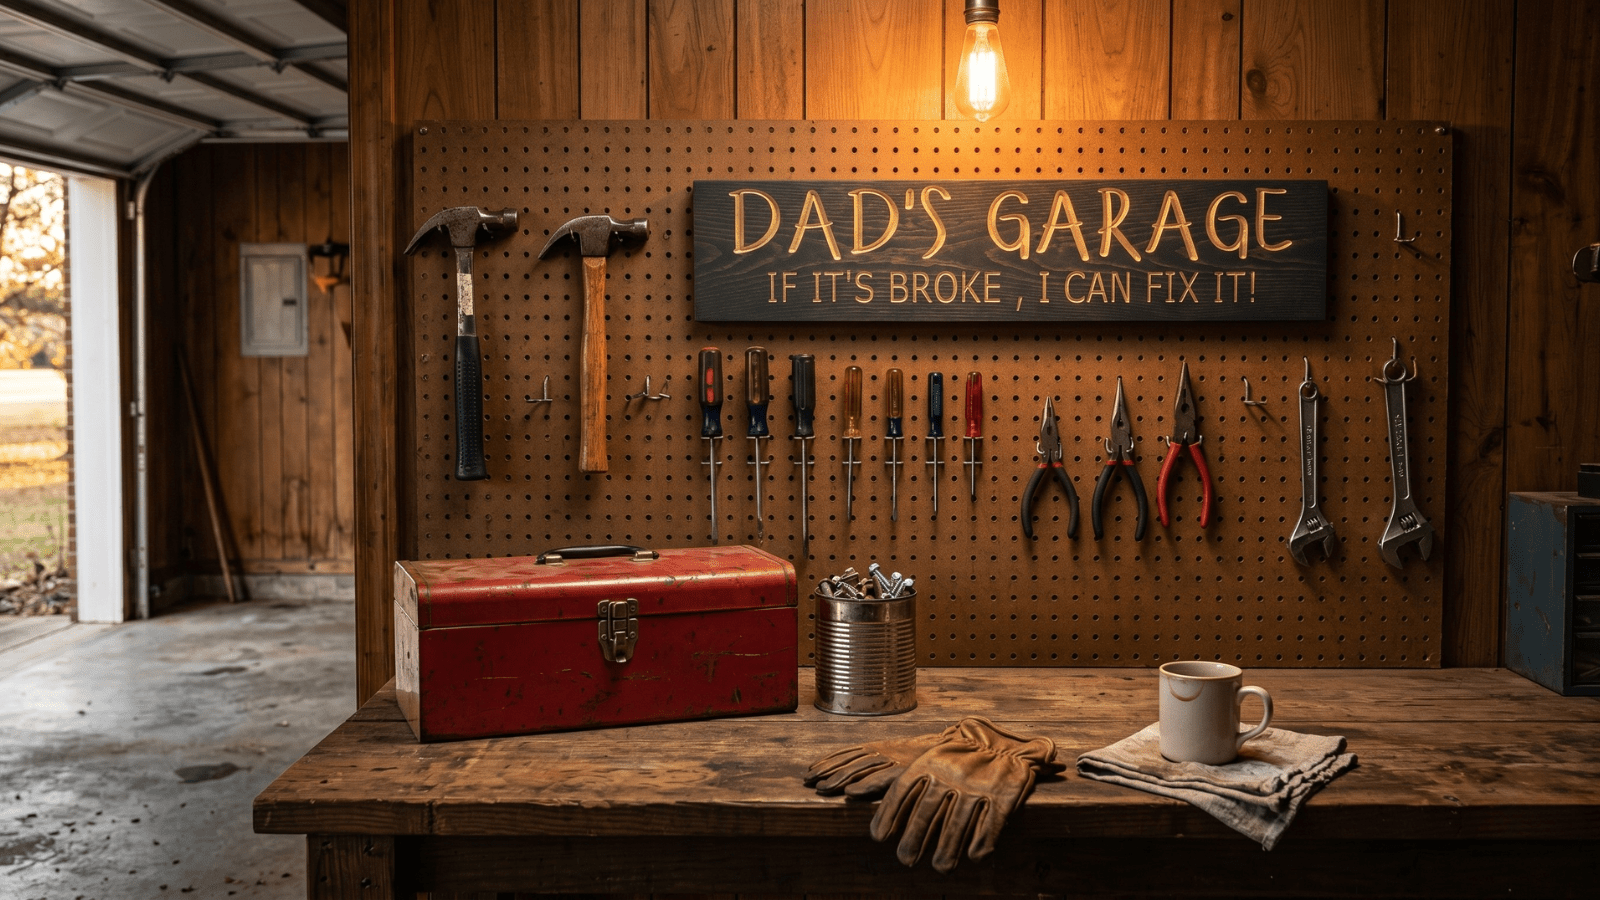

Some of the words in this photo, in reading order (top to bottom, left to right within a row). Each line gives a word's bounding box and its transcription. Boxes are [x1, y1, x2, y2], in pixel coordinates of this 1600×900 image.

[728, 186, 952, 260] DAD'S
[987, 187, 1293, 262] GARAGE
[767, 271, 798, 304] IF
[812, 269, 875, 304] IT'S
[890, 271, 1002, 304] BROKE
[1039, 271, 1051, 304] I
[1064, 270, 1132, 304] CAN
[1146, 271, 1200, 304] FIX
[1214, 271, 1257, 304] IT!
